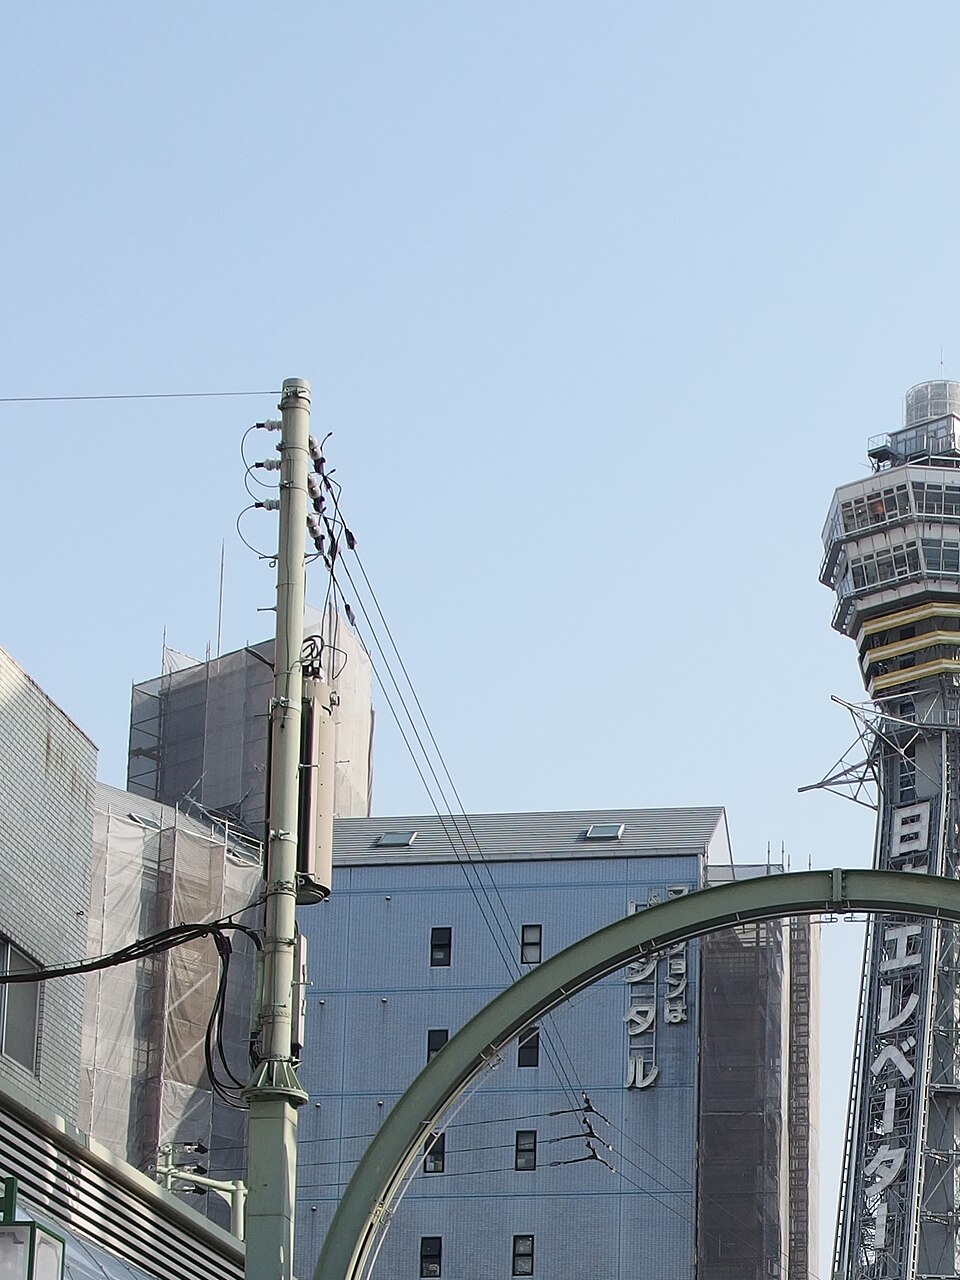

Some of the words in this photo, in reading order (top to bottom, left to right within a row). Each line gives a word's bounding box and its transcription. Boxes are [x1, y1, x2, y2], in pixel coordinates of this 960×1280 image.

[864, 802, 931, 1249] 日エレベーター
